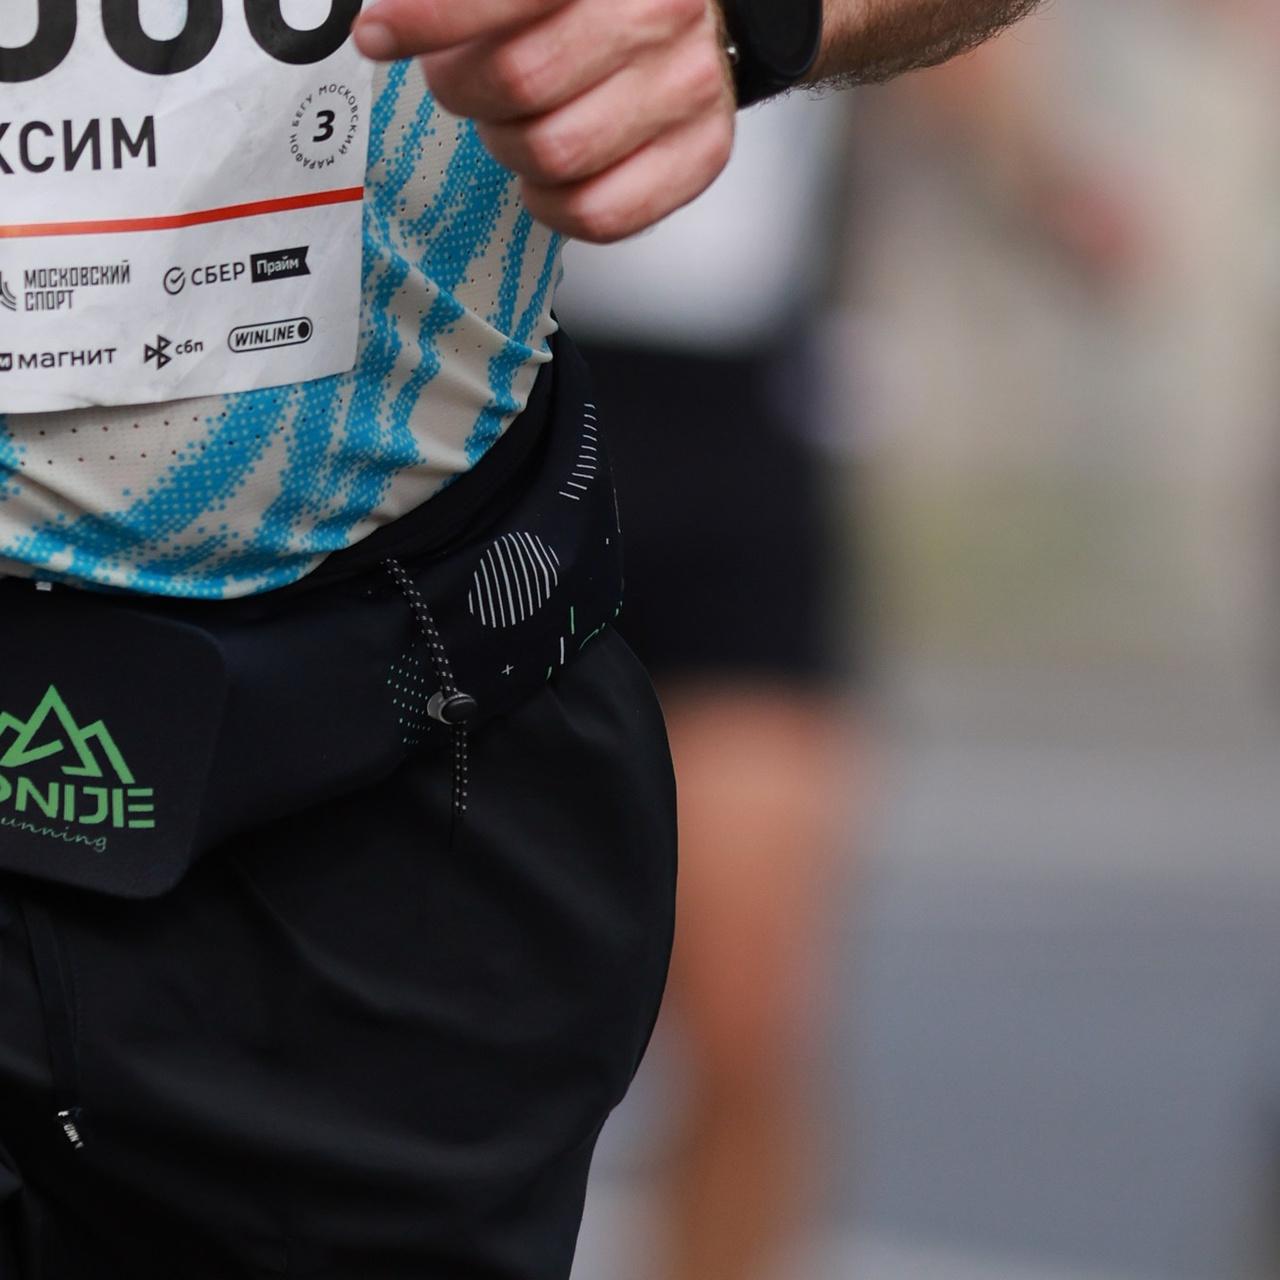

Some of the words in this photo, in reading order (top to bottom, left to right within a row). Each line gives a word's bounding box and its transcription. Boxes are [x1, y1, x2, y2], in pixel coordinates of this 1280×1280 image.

[291, 93, 312, 127] БЕГУ
[318, 83, 359, 155] МОСКОВСКИЙ
[312, 109, 336, 143] 3
[289, 133, 335, 170] МАРАФОН
[24, 259, 131, 289] МОСКОВСКИЙ
[191, 261, 246, 286] СБЕР
[255, 255, 300, 277] Прайм
[25, 289, 75, 312] СПОРТ
[175, 339, 204, 355] сбп
[234, 324, 296, 348] WINLINE
